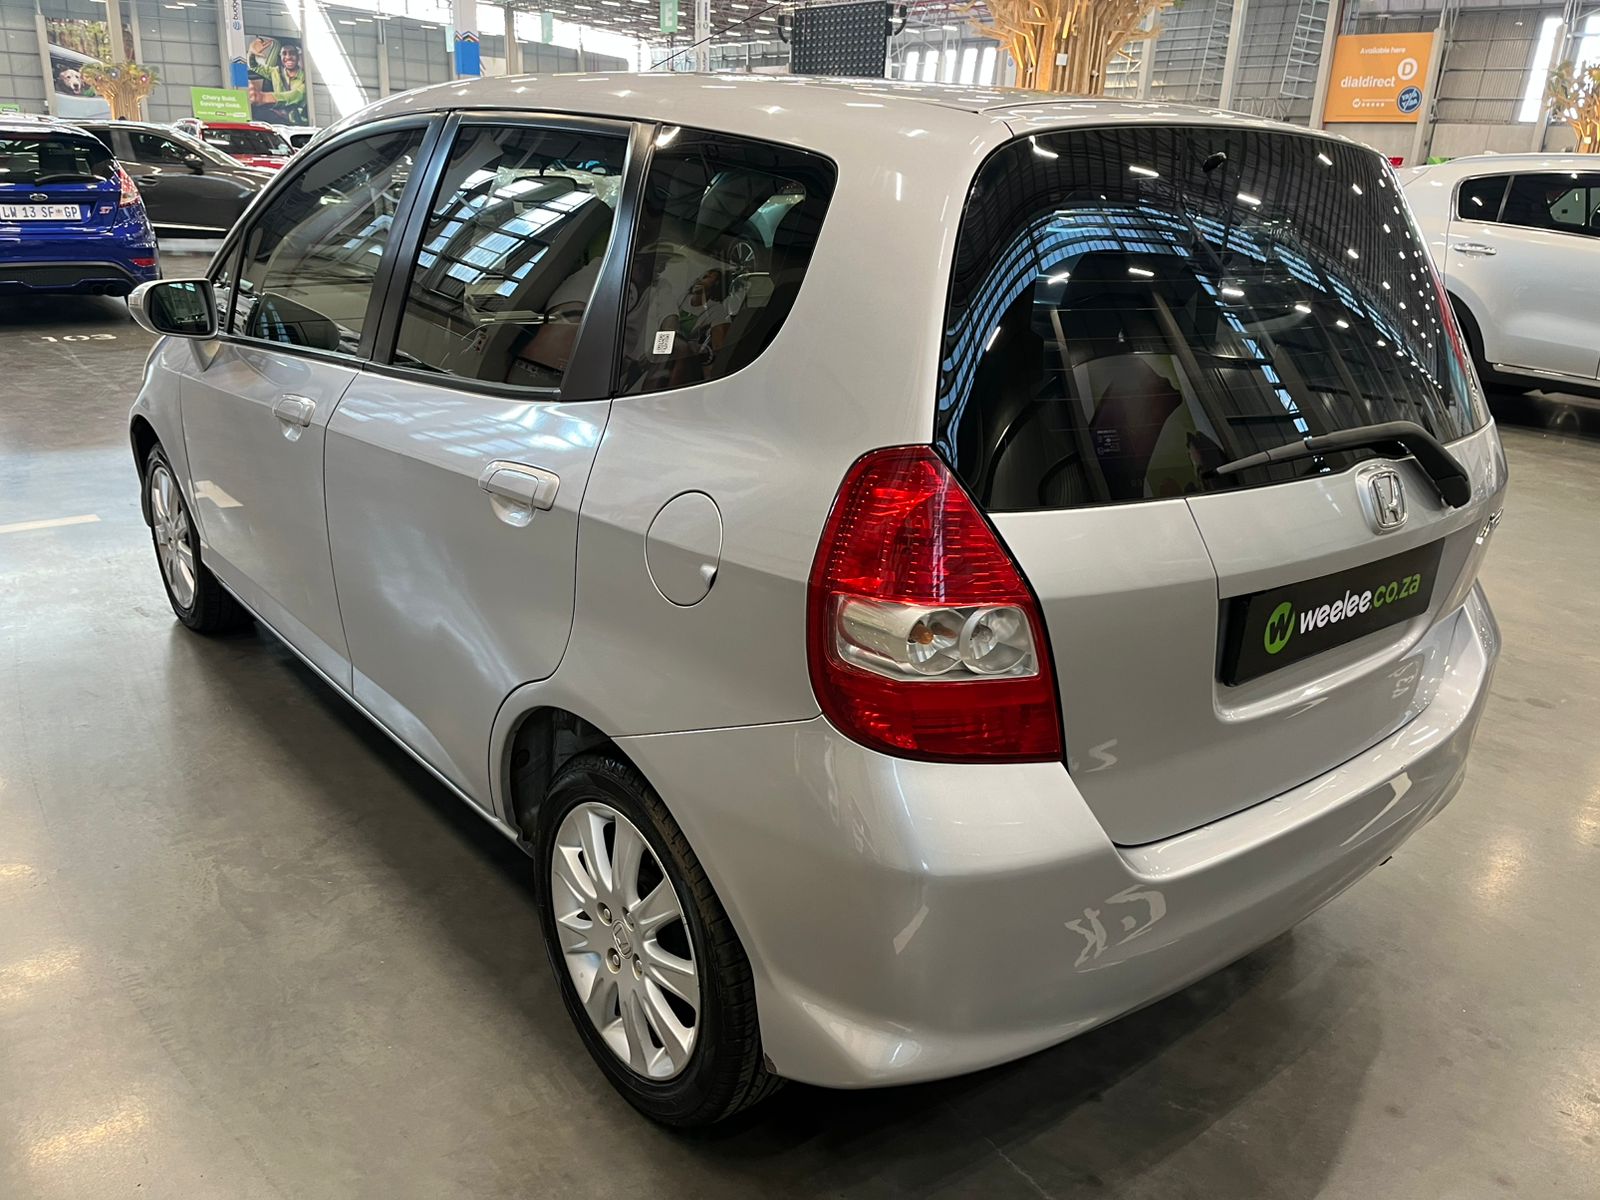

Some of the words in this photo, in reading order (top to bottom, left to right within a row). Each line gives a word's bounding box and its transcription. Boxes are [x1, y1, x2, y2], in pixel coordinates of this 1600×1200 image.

[1360, 47, 1390, 55] Available
[1391, 46, 1406, 54] here
[1341, 75, 1396, 88] dialdirect
[2, 206, 18, 218] LW
[22, 206, 36, 218] 13
[42, 206, 54, 218] SF
[64, 206, 78, 218] GP
[41, 333, 117, 343] 103
[1300, 573, 1421, 635] weelee.co.za
